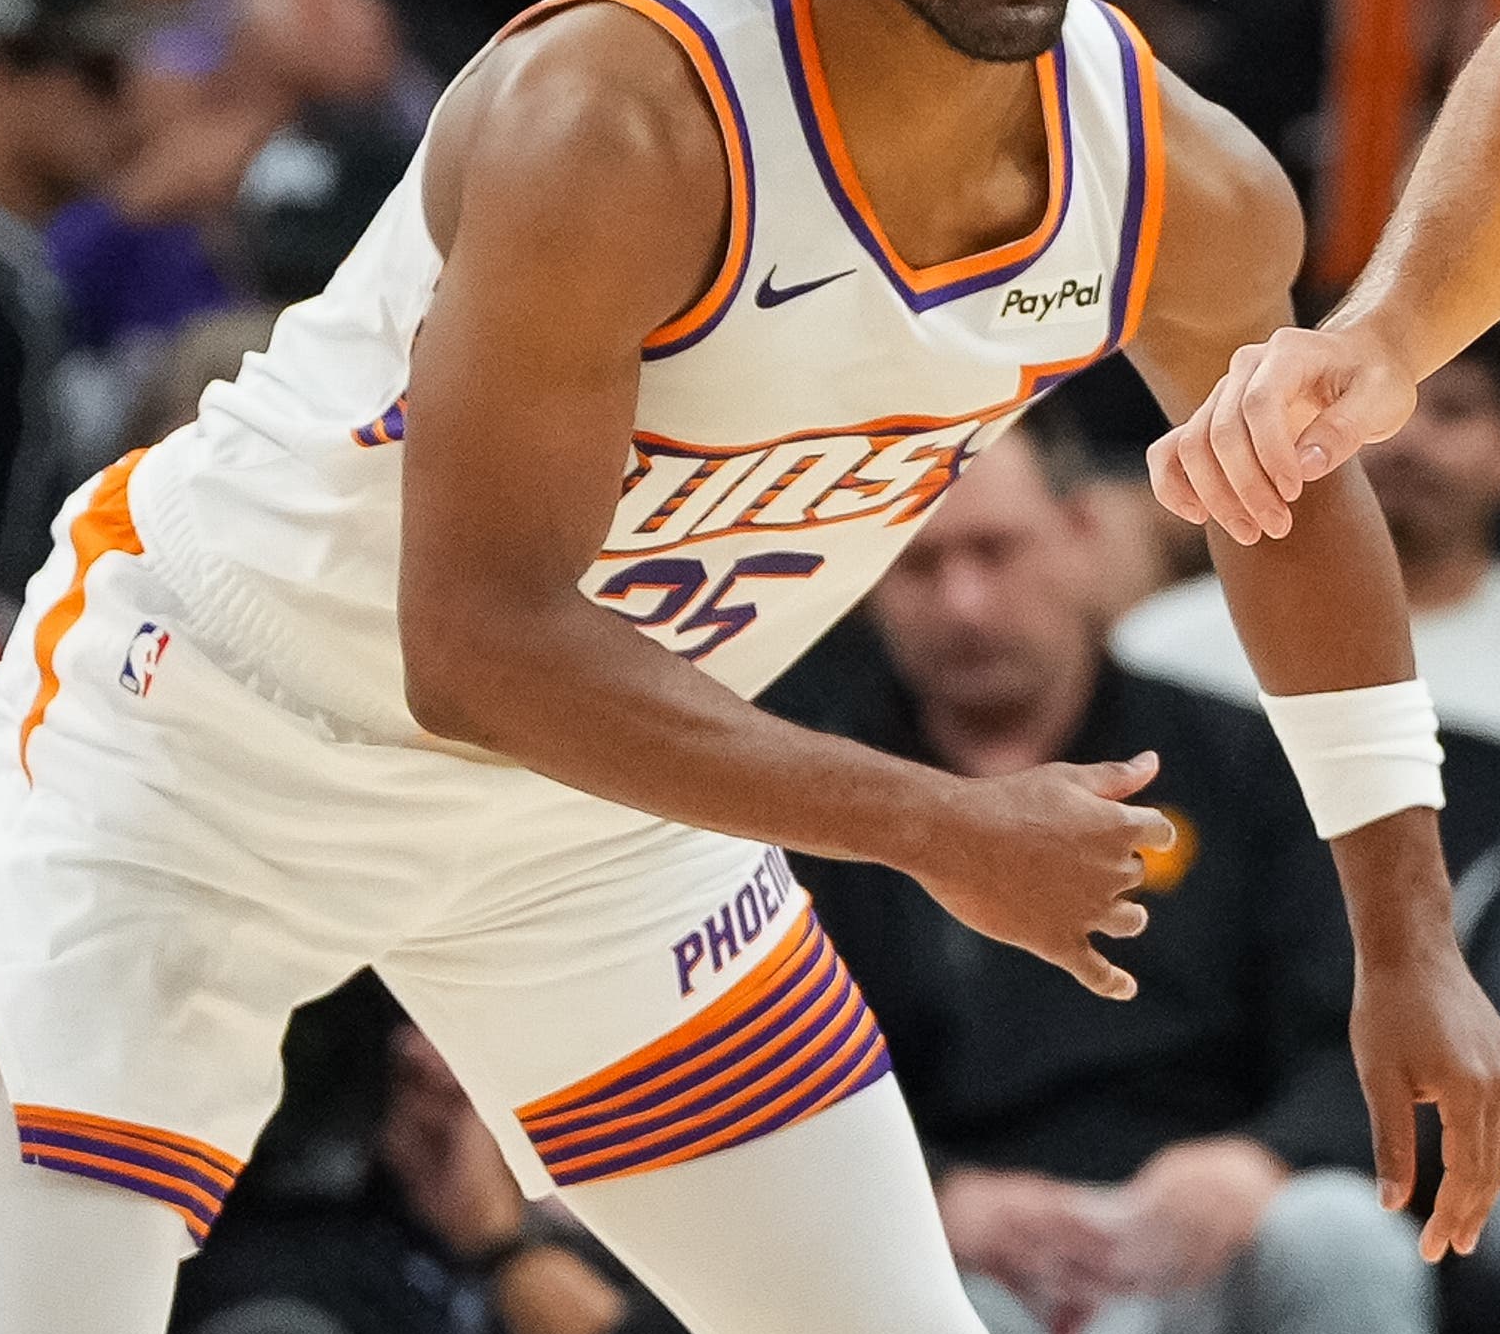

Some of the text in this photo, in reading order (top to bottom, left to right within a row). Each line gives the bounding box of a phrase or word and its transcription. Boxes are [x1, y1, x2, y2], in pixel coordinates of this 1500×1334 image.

[1000, 273, 1102, 323] PayPal
[601, 420, 982, 554] UNS
[671, 845, 792, 999] PHOEN
